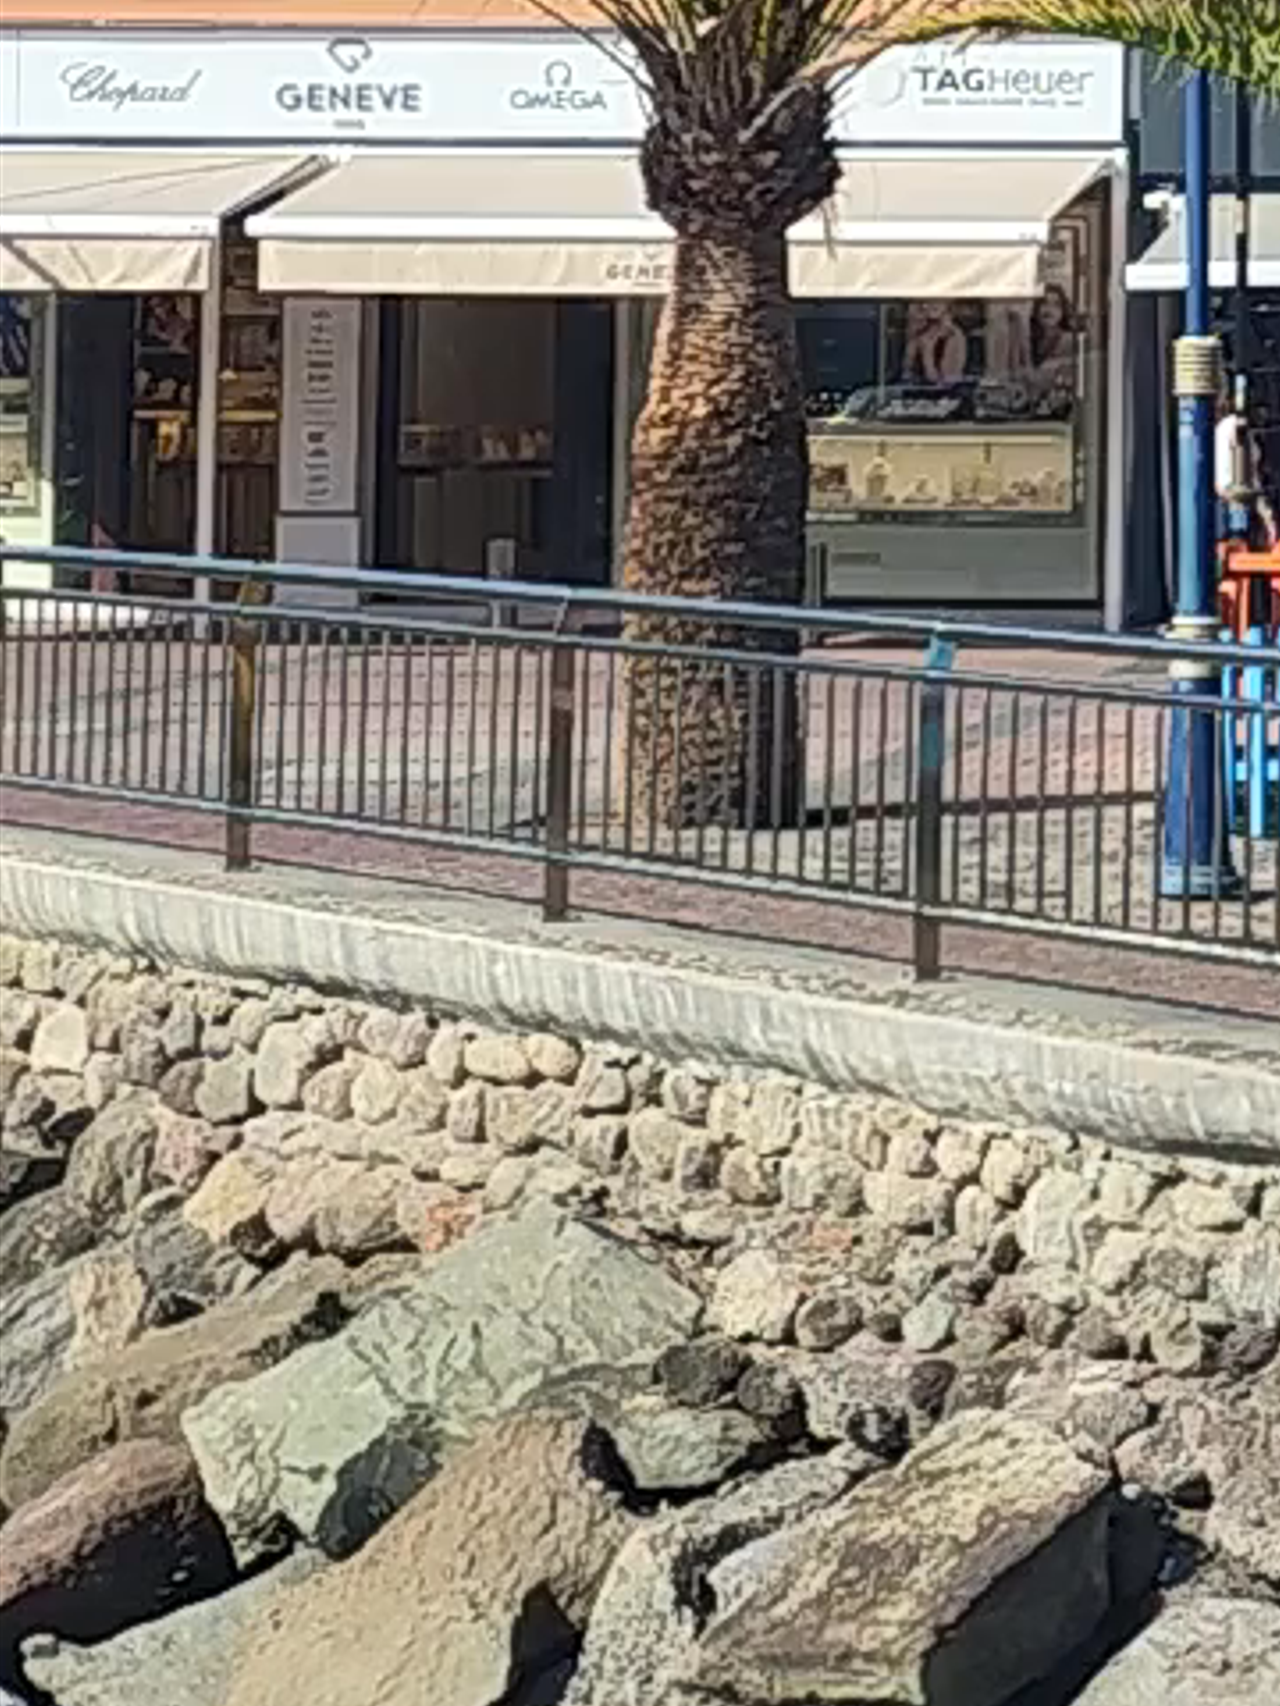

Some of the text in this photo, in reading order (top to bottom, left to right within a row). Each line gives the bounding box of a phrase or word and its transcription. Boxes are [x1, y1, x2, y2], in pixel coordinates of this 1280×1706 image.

[60, 61, 203, 112] Chopard
[275, 83, 423, 113] GENEVE
[510, 89, 608, 110] OMEGA
[605, 264, 669, 280] GENE
